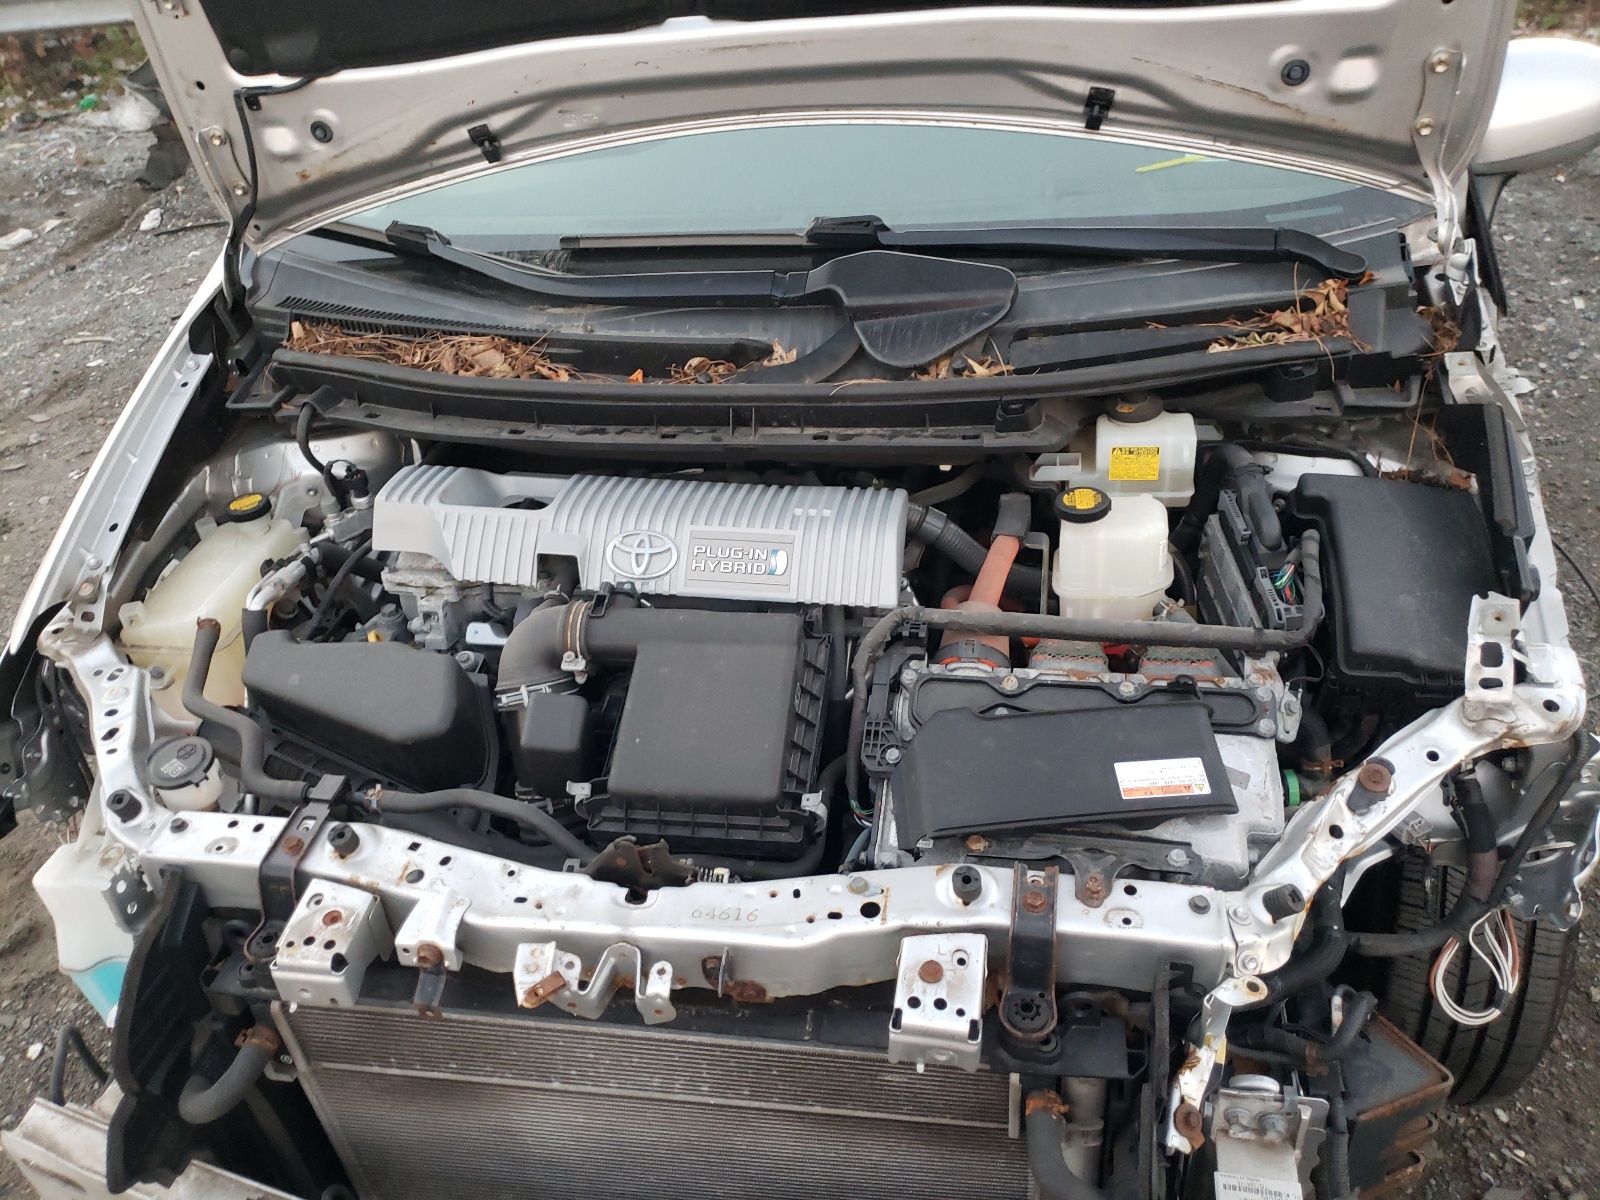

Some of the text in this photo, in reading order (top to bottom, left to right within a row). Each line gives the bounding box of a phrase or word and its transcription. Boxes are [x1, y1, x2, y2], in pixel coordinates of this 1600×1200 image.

[693, 545, 768, 560] PLUG-IN
[691, 559, 766, 575] HYBRID
[691, 906, 759, 922] 64616
